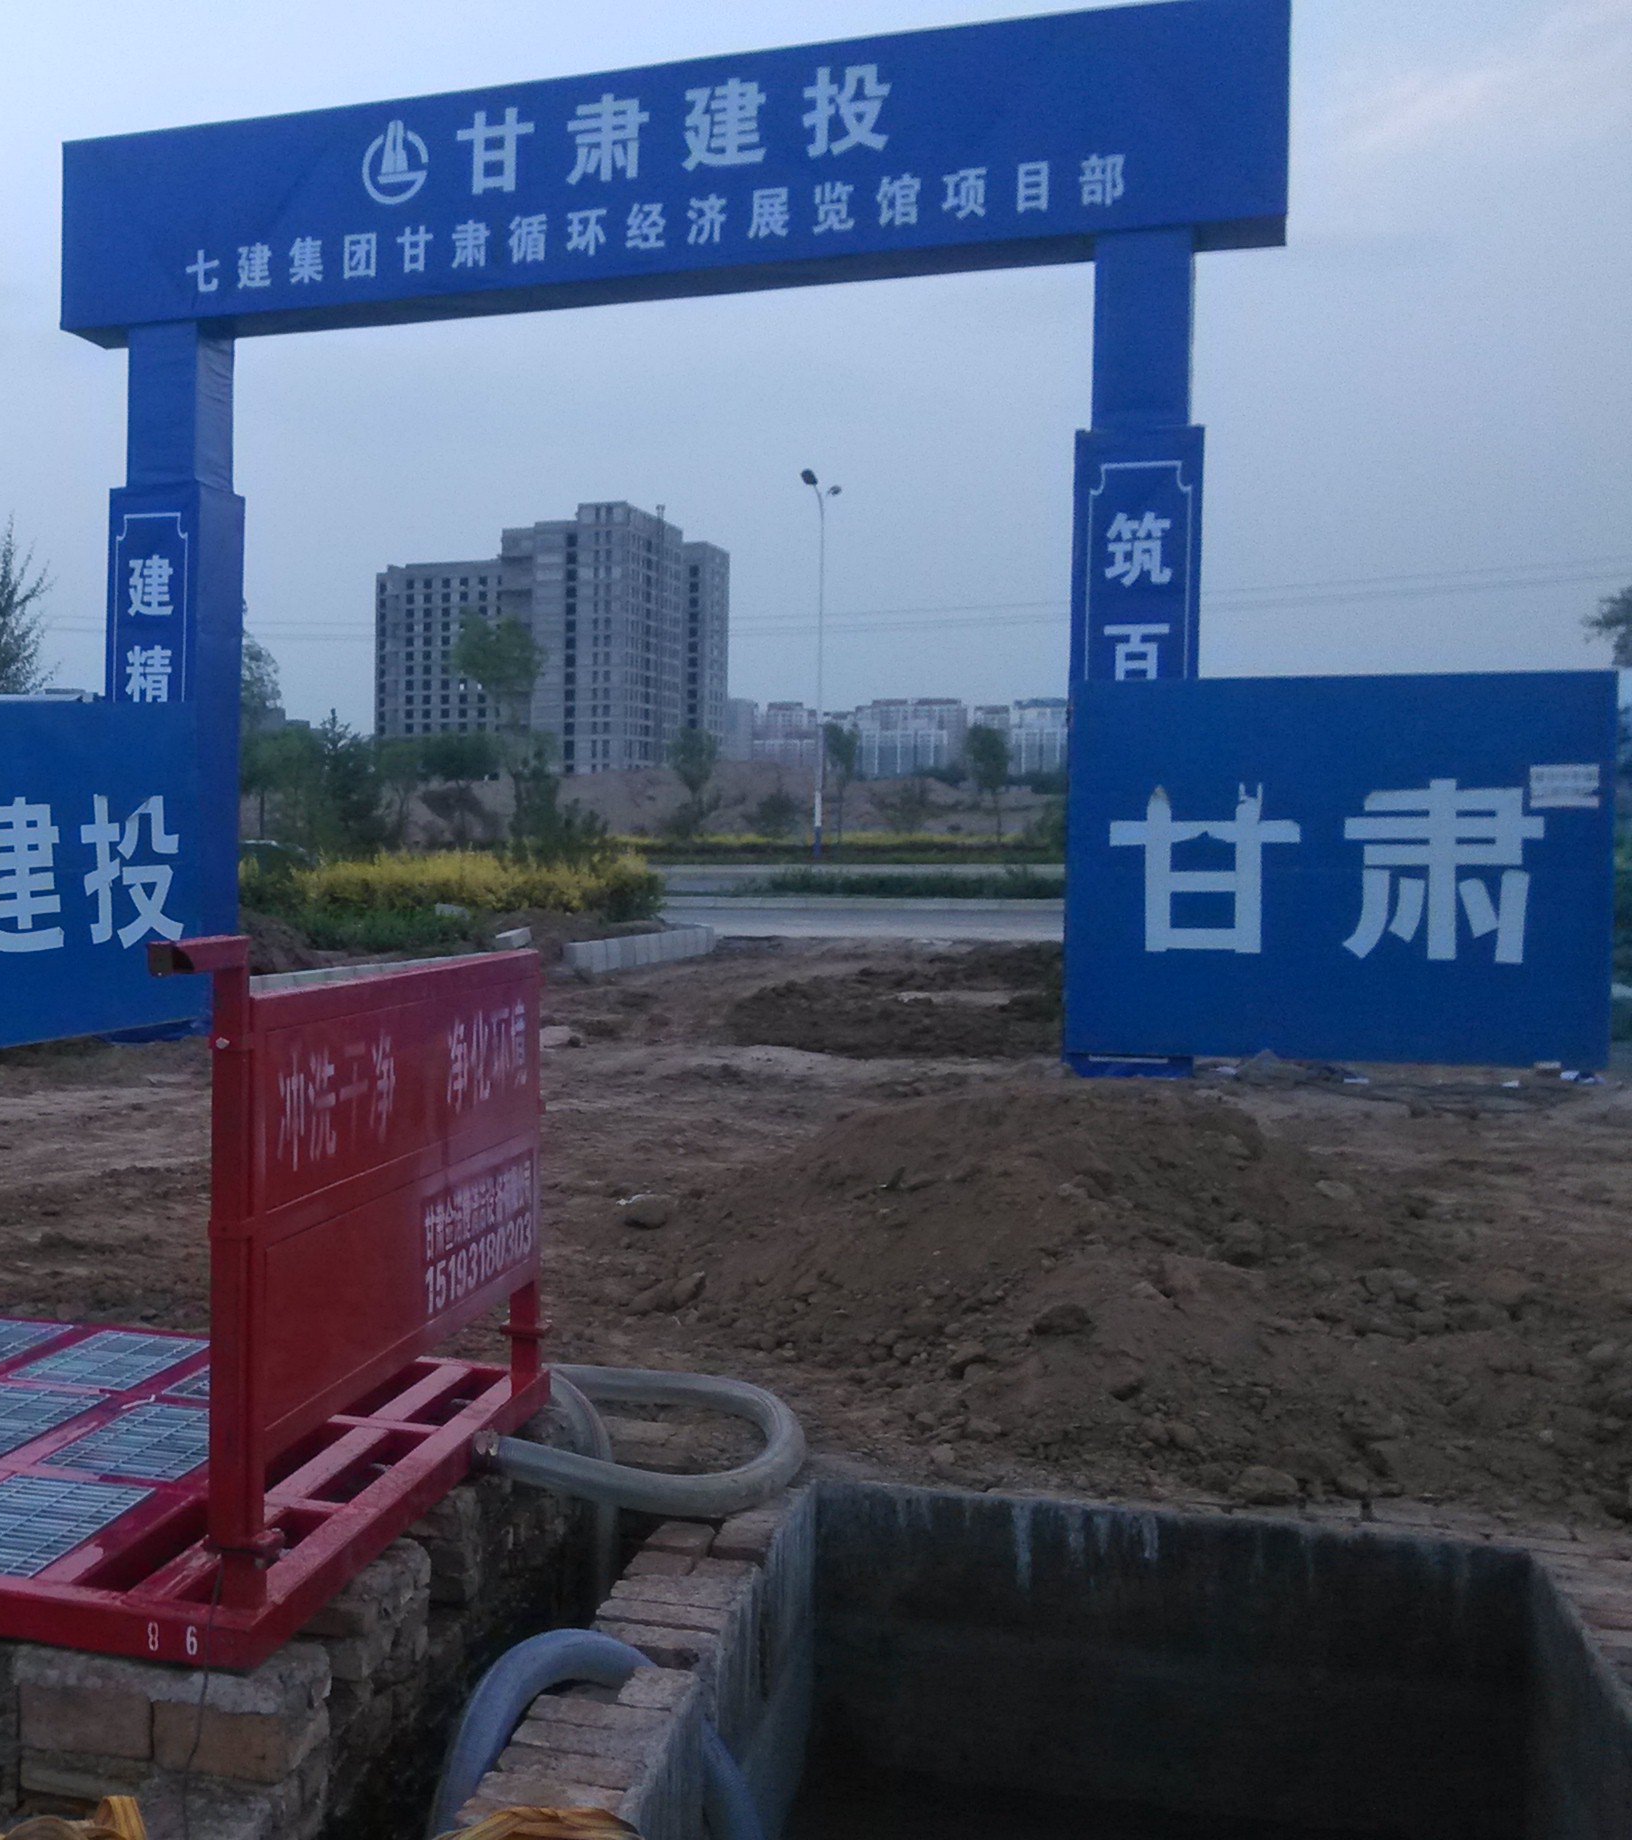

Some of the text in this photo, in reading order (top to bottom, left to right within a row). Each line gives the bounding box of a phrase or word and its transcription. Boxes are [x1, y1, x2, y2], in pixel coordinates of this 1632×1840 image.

[455, 63, 892, 196] 甘肃建投
[184, 153, 1126, 294] 七建集团甘肃循环经济展览馆项目部
[1109, 779, 1545, 964] 甘肃
[424, 1211, 533, 1315] 15193180303
